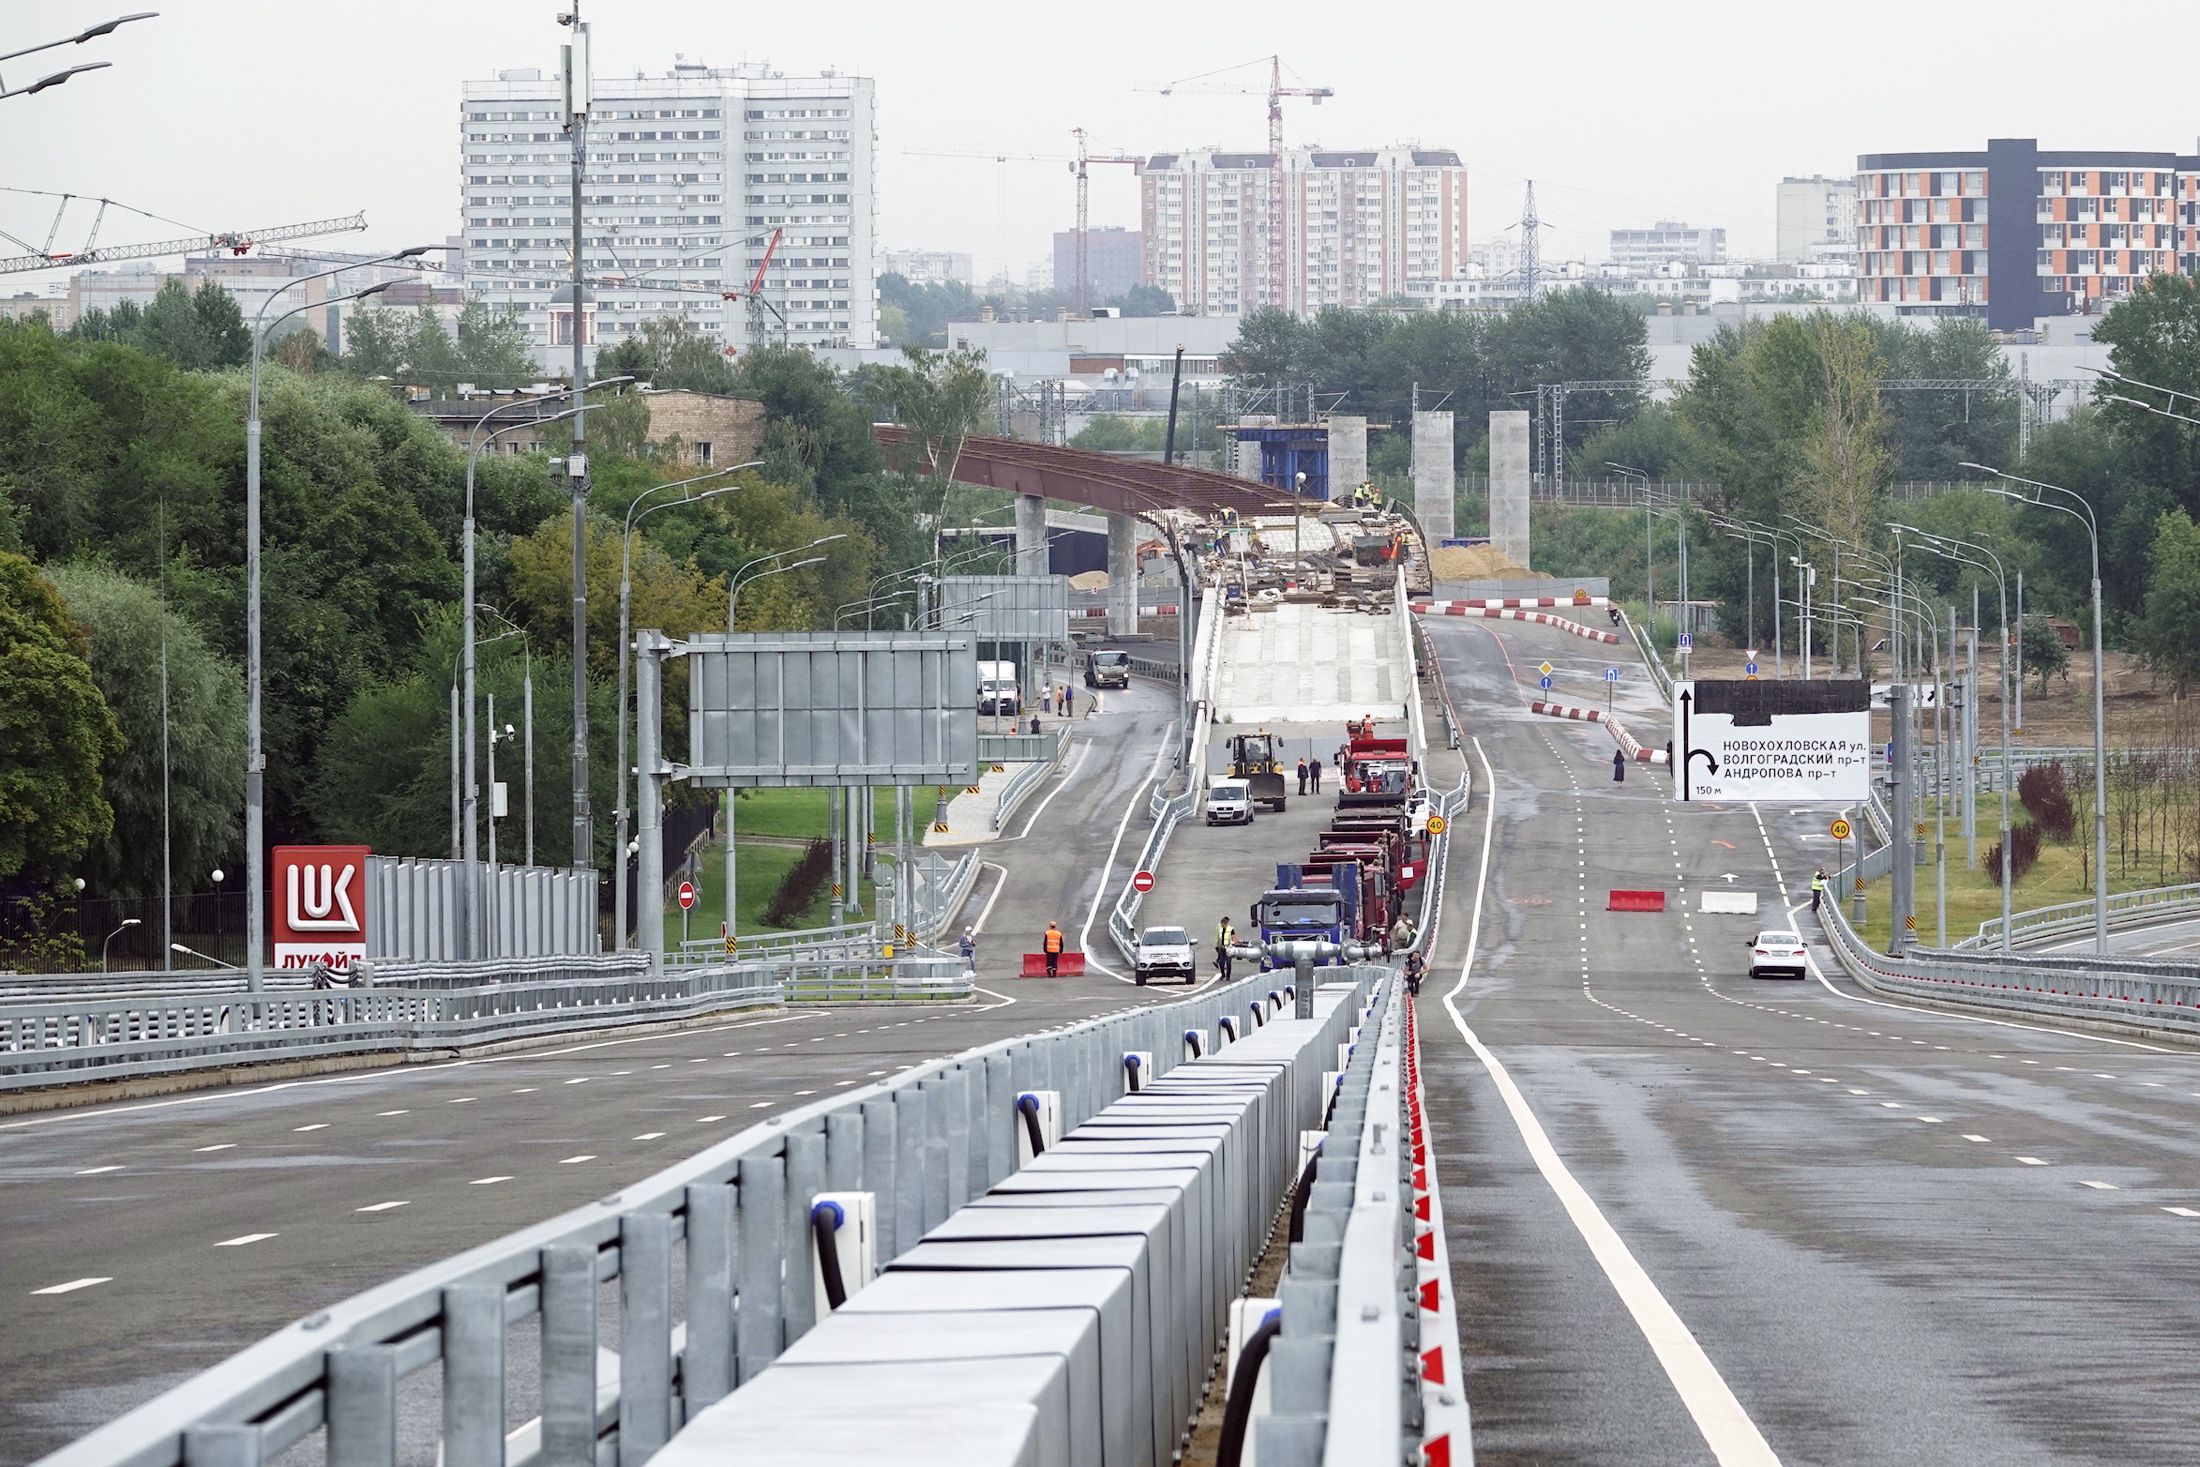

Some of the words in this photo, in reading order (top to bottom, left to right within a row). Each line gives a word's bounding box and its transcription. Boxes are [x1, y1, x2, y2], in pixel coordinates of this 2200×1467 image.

[1723, 740, 1846, 751] НОВОХОХЛОВСКАЯ
[1849, 743, 1867, 753] ул.
[1723, 753, 1833, 765] ВОЛГОГРАДСКИЙ
[1838, 756, 1866, 767] пр-т
[1724, 768, 1803, 779] АНДРОПОВА
[1808, 770, 1836, 780] пр-т
[1696, 786, 1712, 795] 150
[1429, 821, 1442, 829] 40
[1834, 825, 1847, 834] 40
